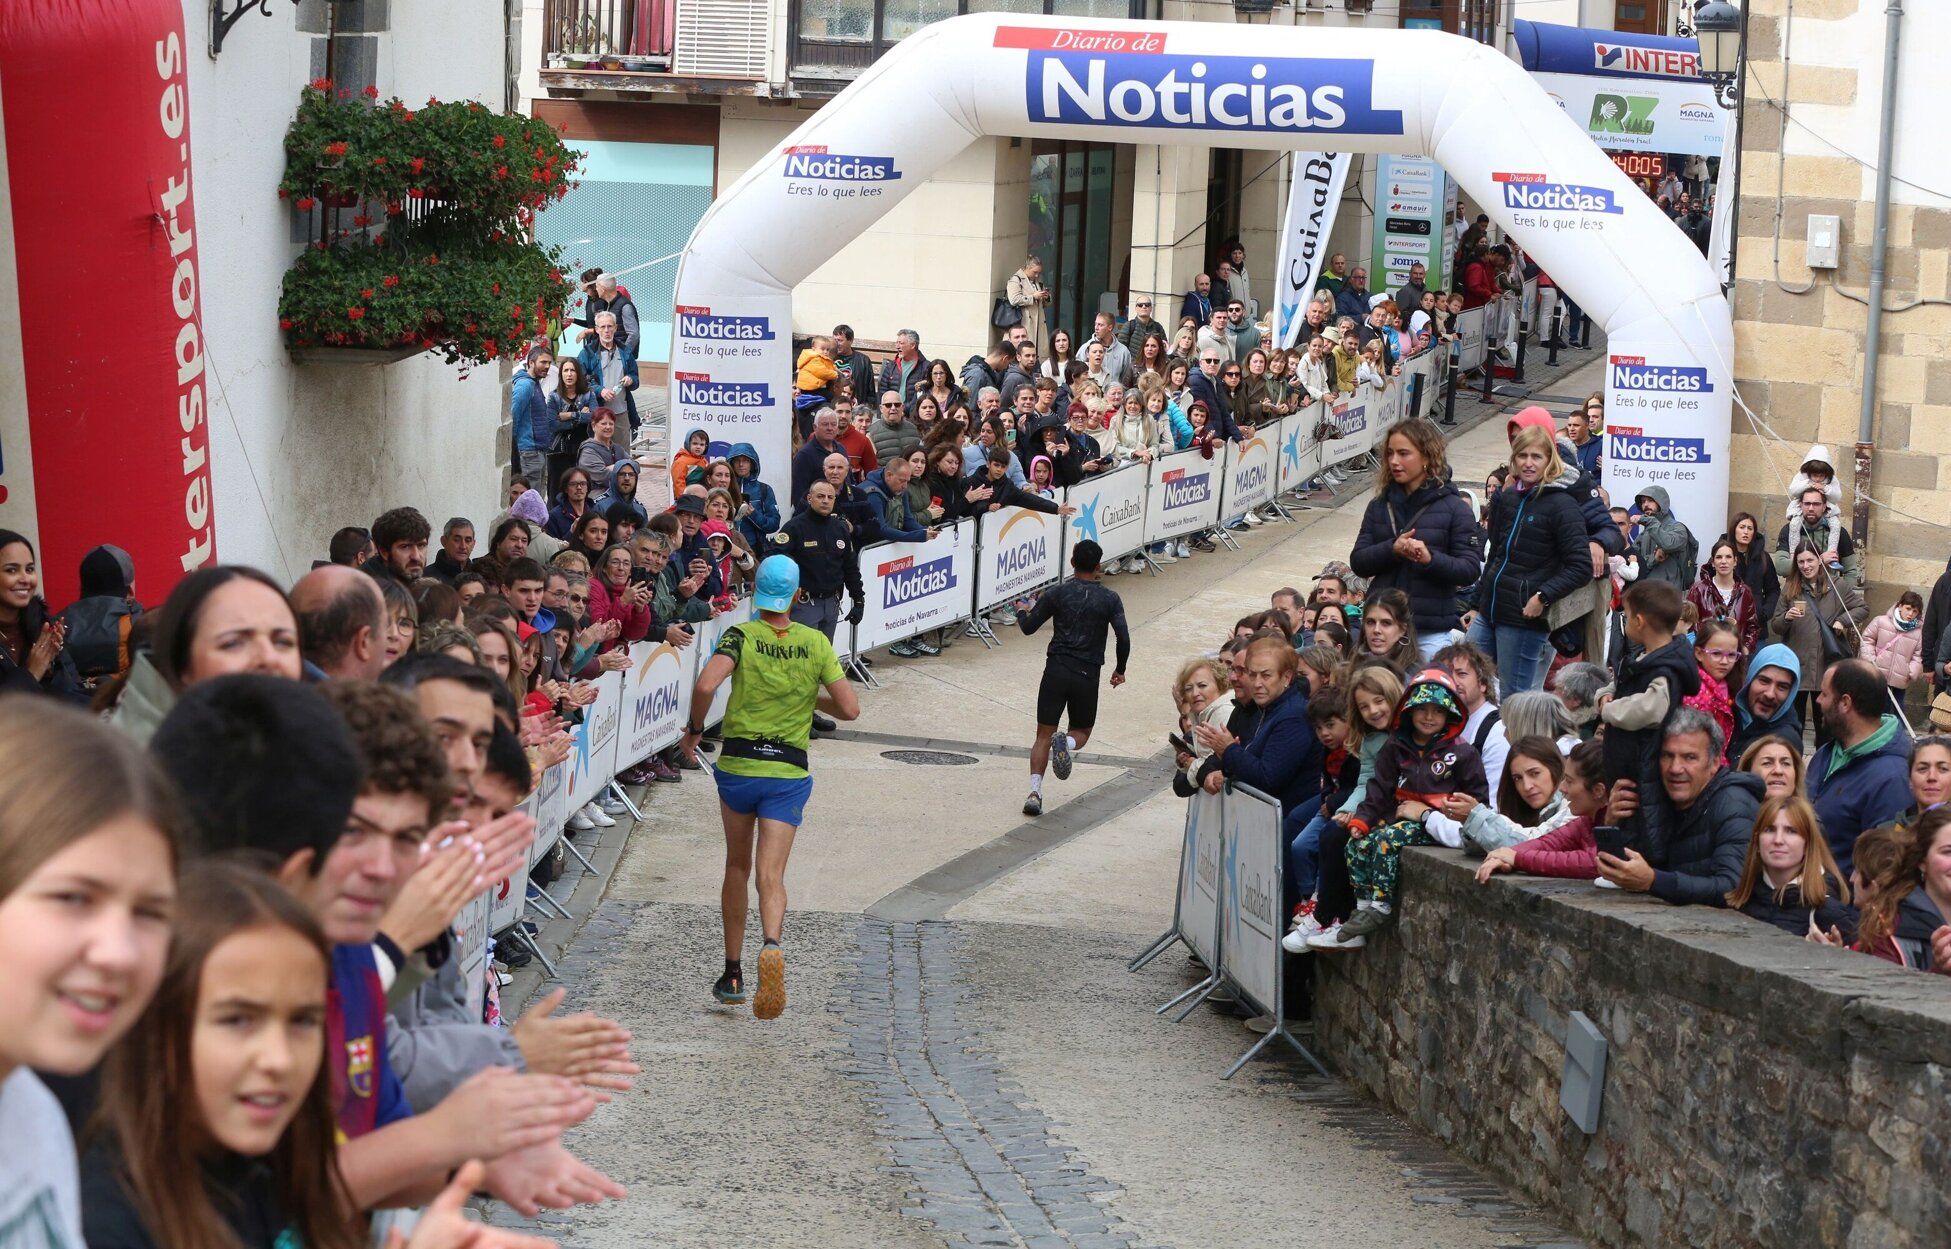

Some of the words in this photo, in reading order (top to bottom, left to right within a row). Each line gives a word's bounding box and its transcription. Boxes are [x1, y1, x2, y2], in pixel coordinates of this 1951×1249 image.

[1051, 30, 1126, 51] Diario
[1132, 33, 1160, 52] de
[1042, 57, 1346, 128] Noticias
[1680, 110, 1715, 119] MAGNA
[795, 146, 815, 154] Diario
[817, 146, 826, 154] de
[787, 156, 885, 179] Noticias
[1509, 173, 1534, 183] Diario
[1535, 174, 1545, 183] de
[787, 183, 813, 195] Eres
[817, 185, 829, 196] lo
[833, 188, 856, 200] que
[860, 185, 883, 197] lees
[1507, 184, 1606, 211] Noticias
[1513, 213, 1535, 228] Eres
[1539, 216, 1549, 229] lo
[1553, 219, 1576, 232] que
[1580, 217, 1604, 231] lees
[682, 316, 763, 339] Noticias
[683, 342, 701, 355] Eres
[704, 344, 713, 355] lo
[717, 347, 738, 359] que
[742, 345, 762, 356] lees
[1617, 357, 1634, 365] Diario
[683, 373, 700, 381] Diario
[701, 374, 709, 382] de
[1615, 366, 1700, 391] Noticias
[681, 383, 762, 405] Noticias
[1616, 394, 1634, 407] Eres
[1638, 396, 1647, 408] lo
[1651, 399, 1673, 412] que
[1677, 397, 1699, 409] lees
[683, 409, 700, 421] Eres
[704, 410, 713, 422] lo
[717, 414, 738, 425] que
[741, 412, 762, 423] lees
[1615, 427, 1632, 435] Diario
[1633, 428, 1641, 436] de
[1612, 437, 1697, 461] Noticias
[1234, 462, 1267, 496] MAGNA
[1613, 464, 1631, 478] Eres
[1635, 466, 1644, 478] lo
[1648, 470, 1671, 482] que
[1674, 468, 1696, 480] lees
[1165, 478, 1205, 508] Noticias
[1102, 495, 1142, 527] CaixaBank
[906, 558, 913, 568] de
[996, 536, 1046, 579] MAGNA
[886, 565, 948, 605] Noticias
[995, 575, 1024, 595] MAGNESITAS
[1023, 565, 1046, 583] NAVARRAS
[908, 614, 915, 624] de
[916, 608, 938, 621] Navarra
[633, 679, 679, 733] MAGNA
[1240, 862, 1273, 927] CaixaBank
